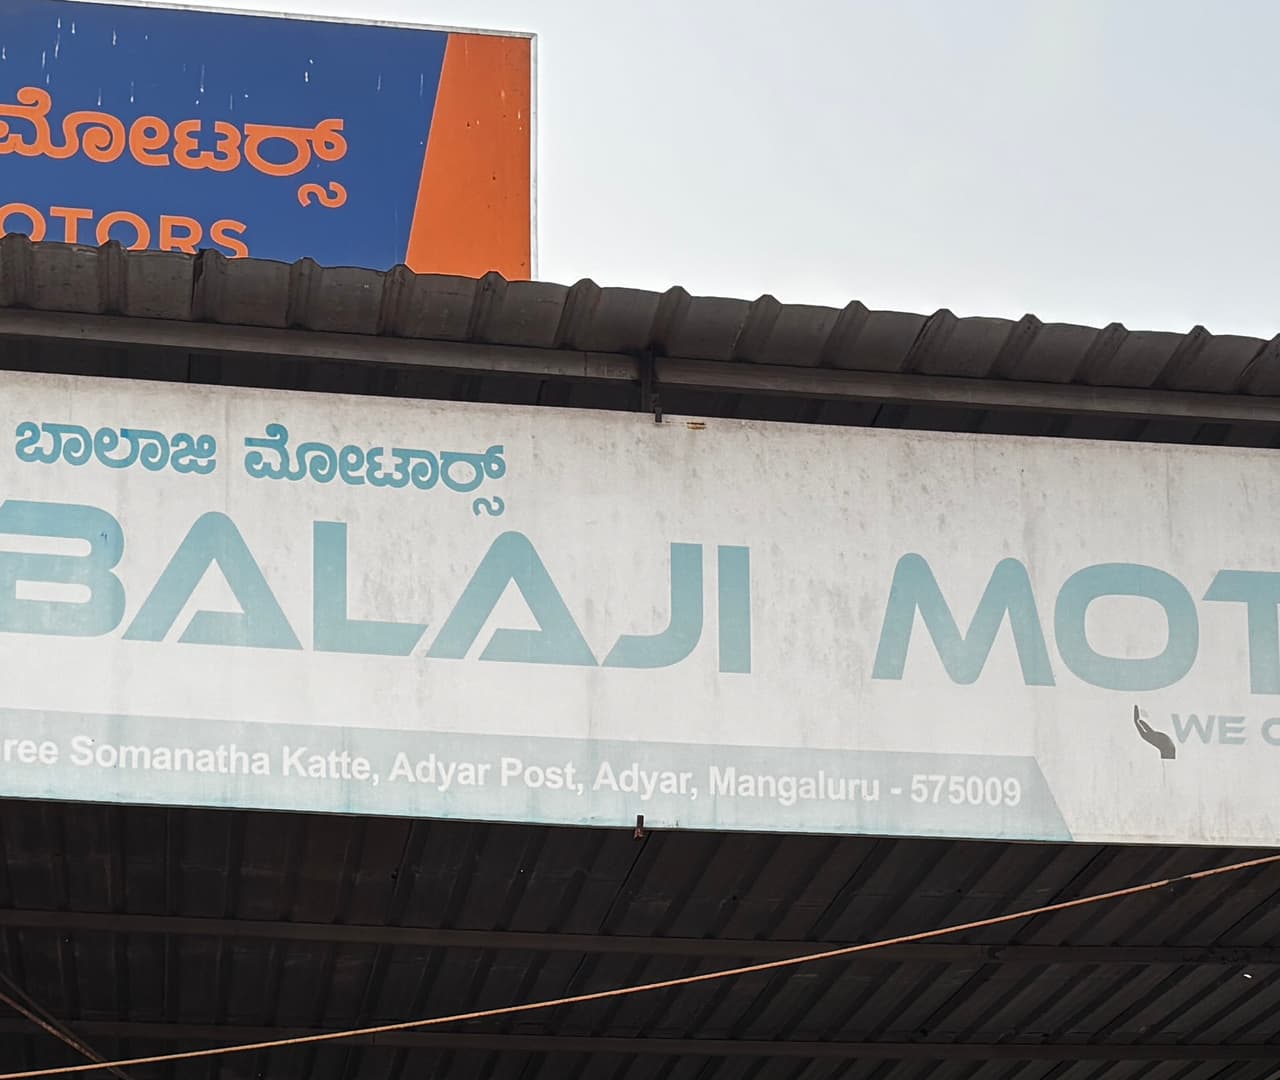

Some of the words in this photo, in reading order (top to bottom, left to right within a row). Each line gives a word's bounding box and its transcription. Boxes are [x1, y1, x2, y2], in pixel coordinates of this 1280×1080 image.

[15, 421, 217, 475] ಬಾಲಾಜಿ
[244, 423, 506, 517] ಮೋಟಾರ್ಸ್
[1171, 713, 1246, 745] WE
[71, 734, 270, 776] Somanatha
[282, 745, 380, 786] Katte,
[388, 752, 491, 792] Adyar
[501, 757, 585, 796] Post,
[593, 760, 698, 800] Adyar,
[709, 765, 881, 806] Mangaluru
[911, 773, 1022, 806] 575009
